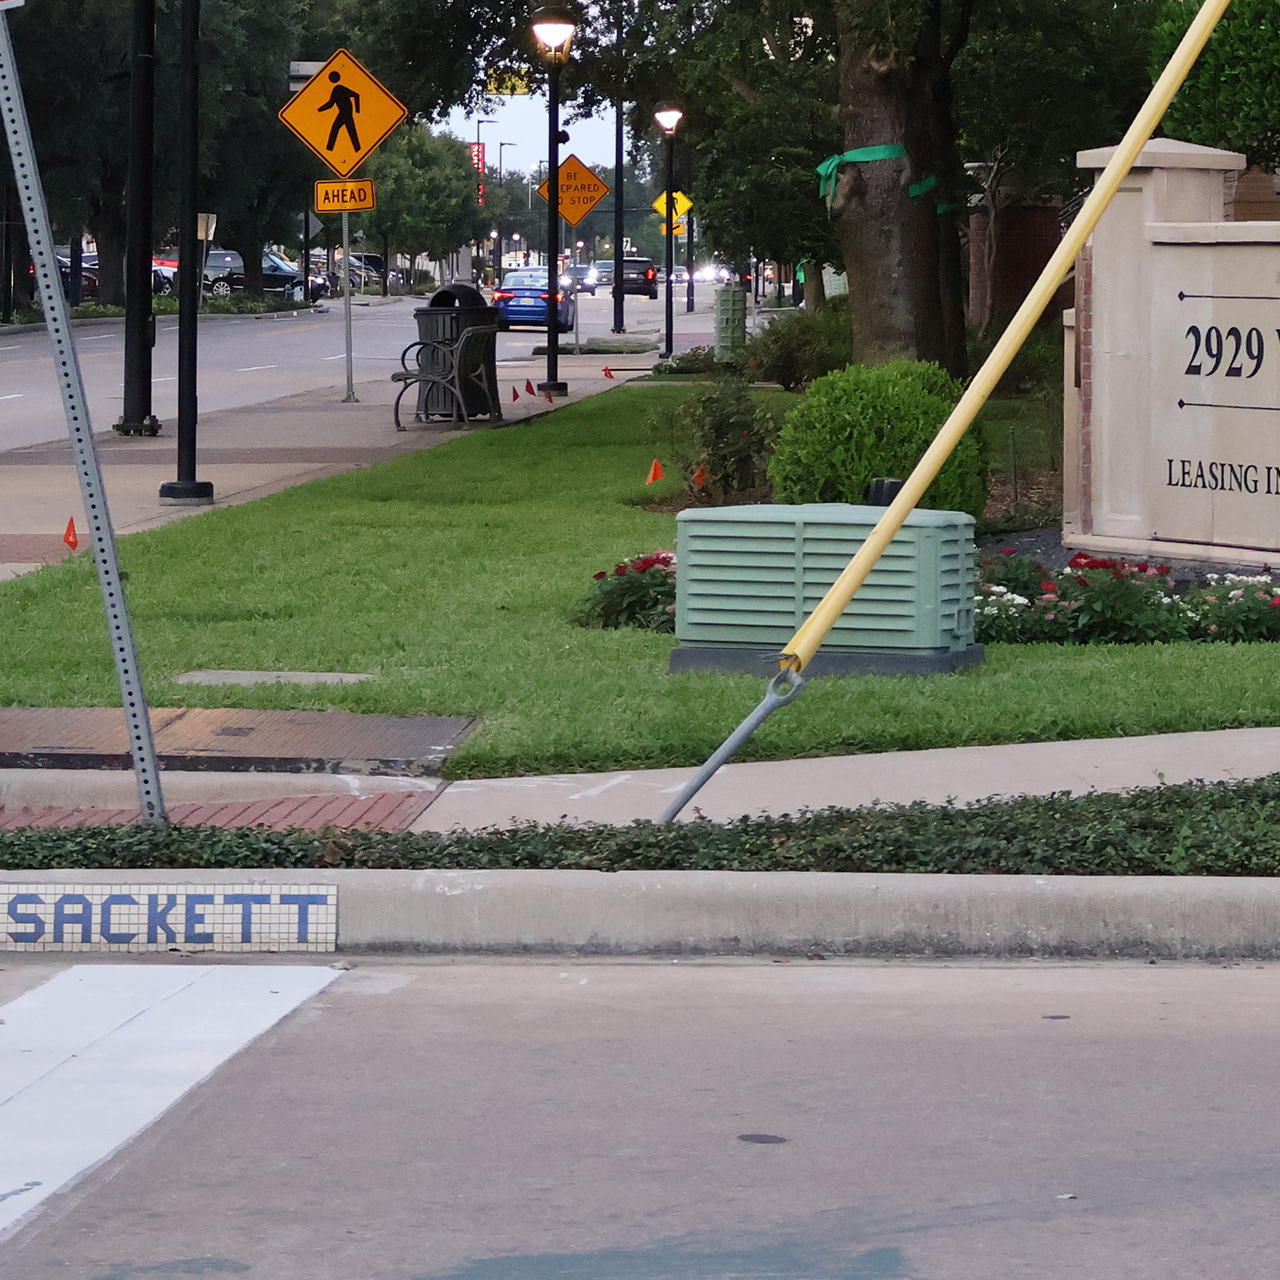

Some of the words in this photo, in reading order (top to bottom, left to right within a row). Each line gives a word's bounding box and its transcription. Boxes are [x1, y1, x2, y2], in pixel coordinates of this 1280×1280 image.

[566, 172, 579, 181] BE
[323, 188, 367, 204] AHEAD
[547, 183, 600, 193] EPARED
[570, 196, 596, 205] STOP
[1184, 324, 1264, 378] 2929
[1166, 458, 1259, 494] LEASING
[8, 893, 328, 943] SACKETT
